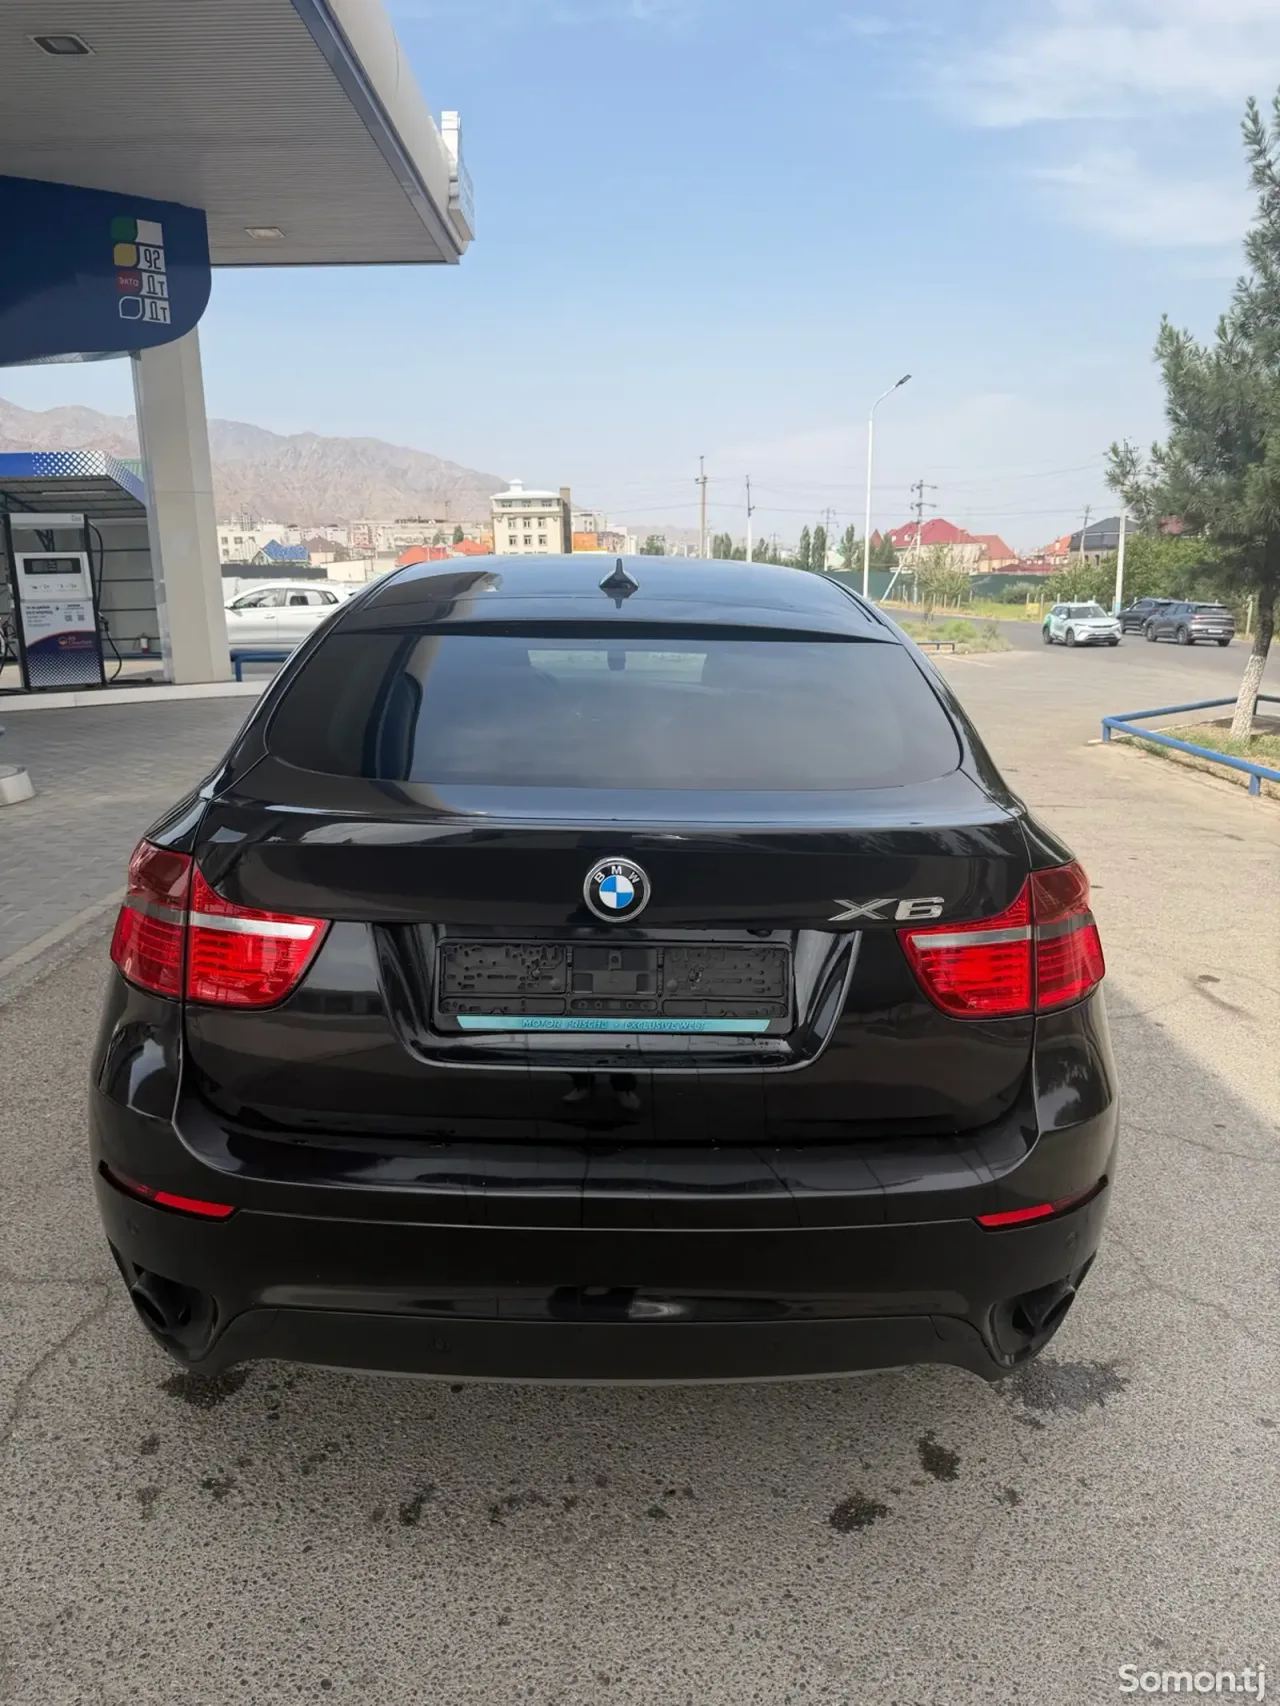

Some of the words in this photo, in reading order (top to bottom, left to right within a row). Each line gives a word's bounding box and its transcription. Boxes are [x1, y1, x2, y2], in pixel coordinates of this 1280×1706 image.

[144, 248, 162, 270] 92
[594, 865, 640, 884] BMW
[827, 896, 945, 921] X6
[522, 1018, 562, 1028] MOTOR
